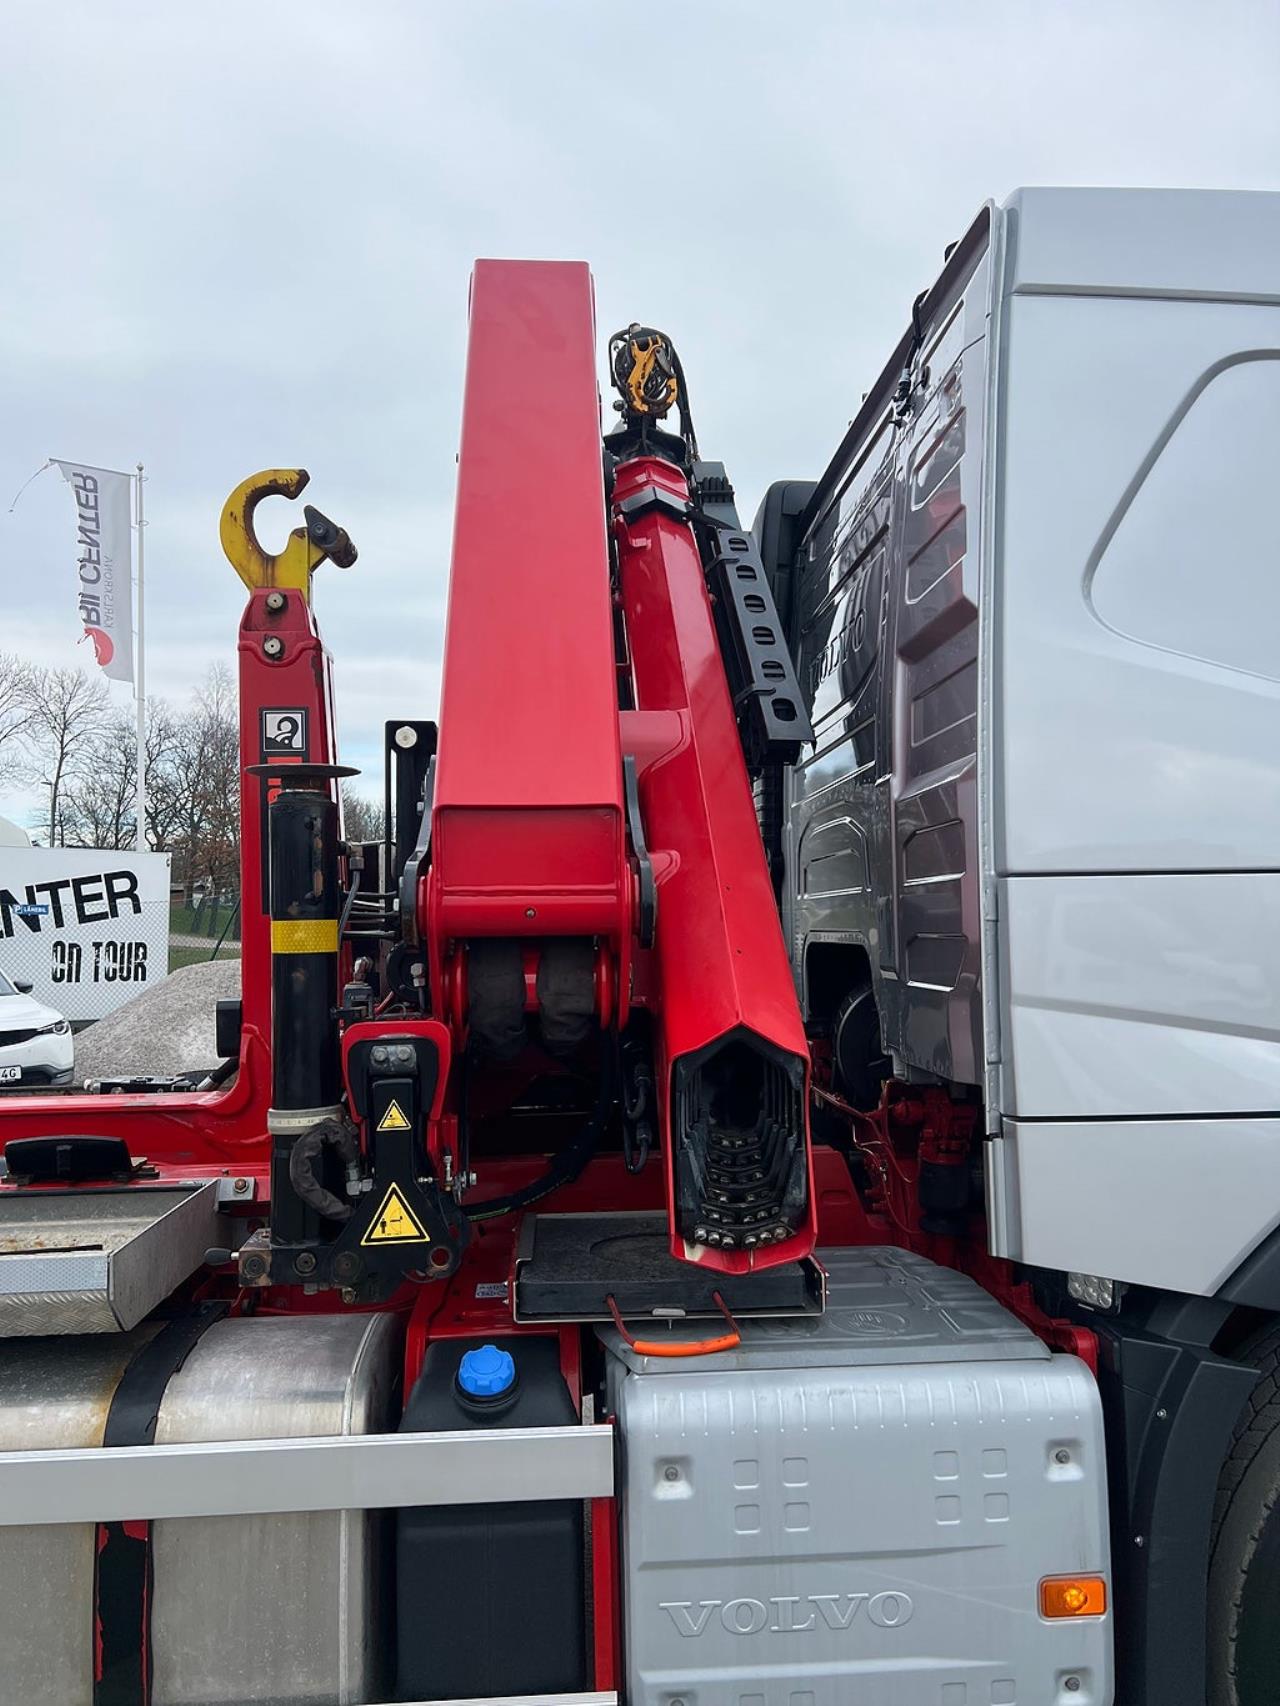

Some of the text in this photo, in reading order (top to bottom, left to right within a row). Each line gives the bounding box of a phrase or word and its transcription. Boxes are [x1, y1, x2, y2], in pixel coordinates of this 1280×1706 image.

[0, 871, 141, 938] NTER
[92, 941, 147, 982] TOUR
[659, 1591, 914, 1637] VOLVO
